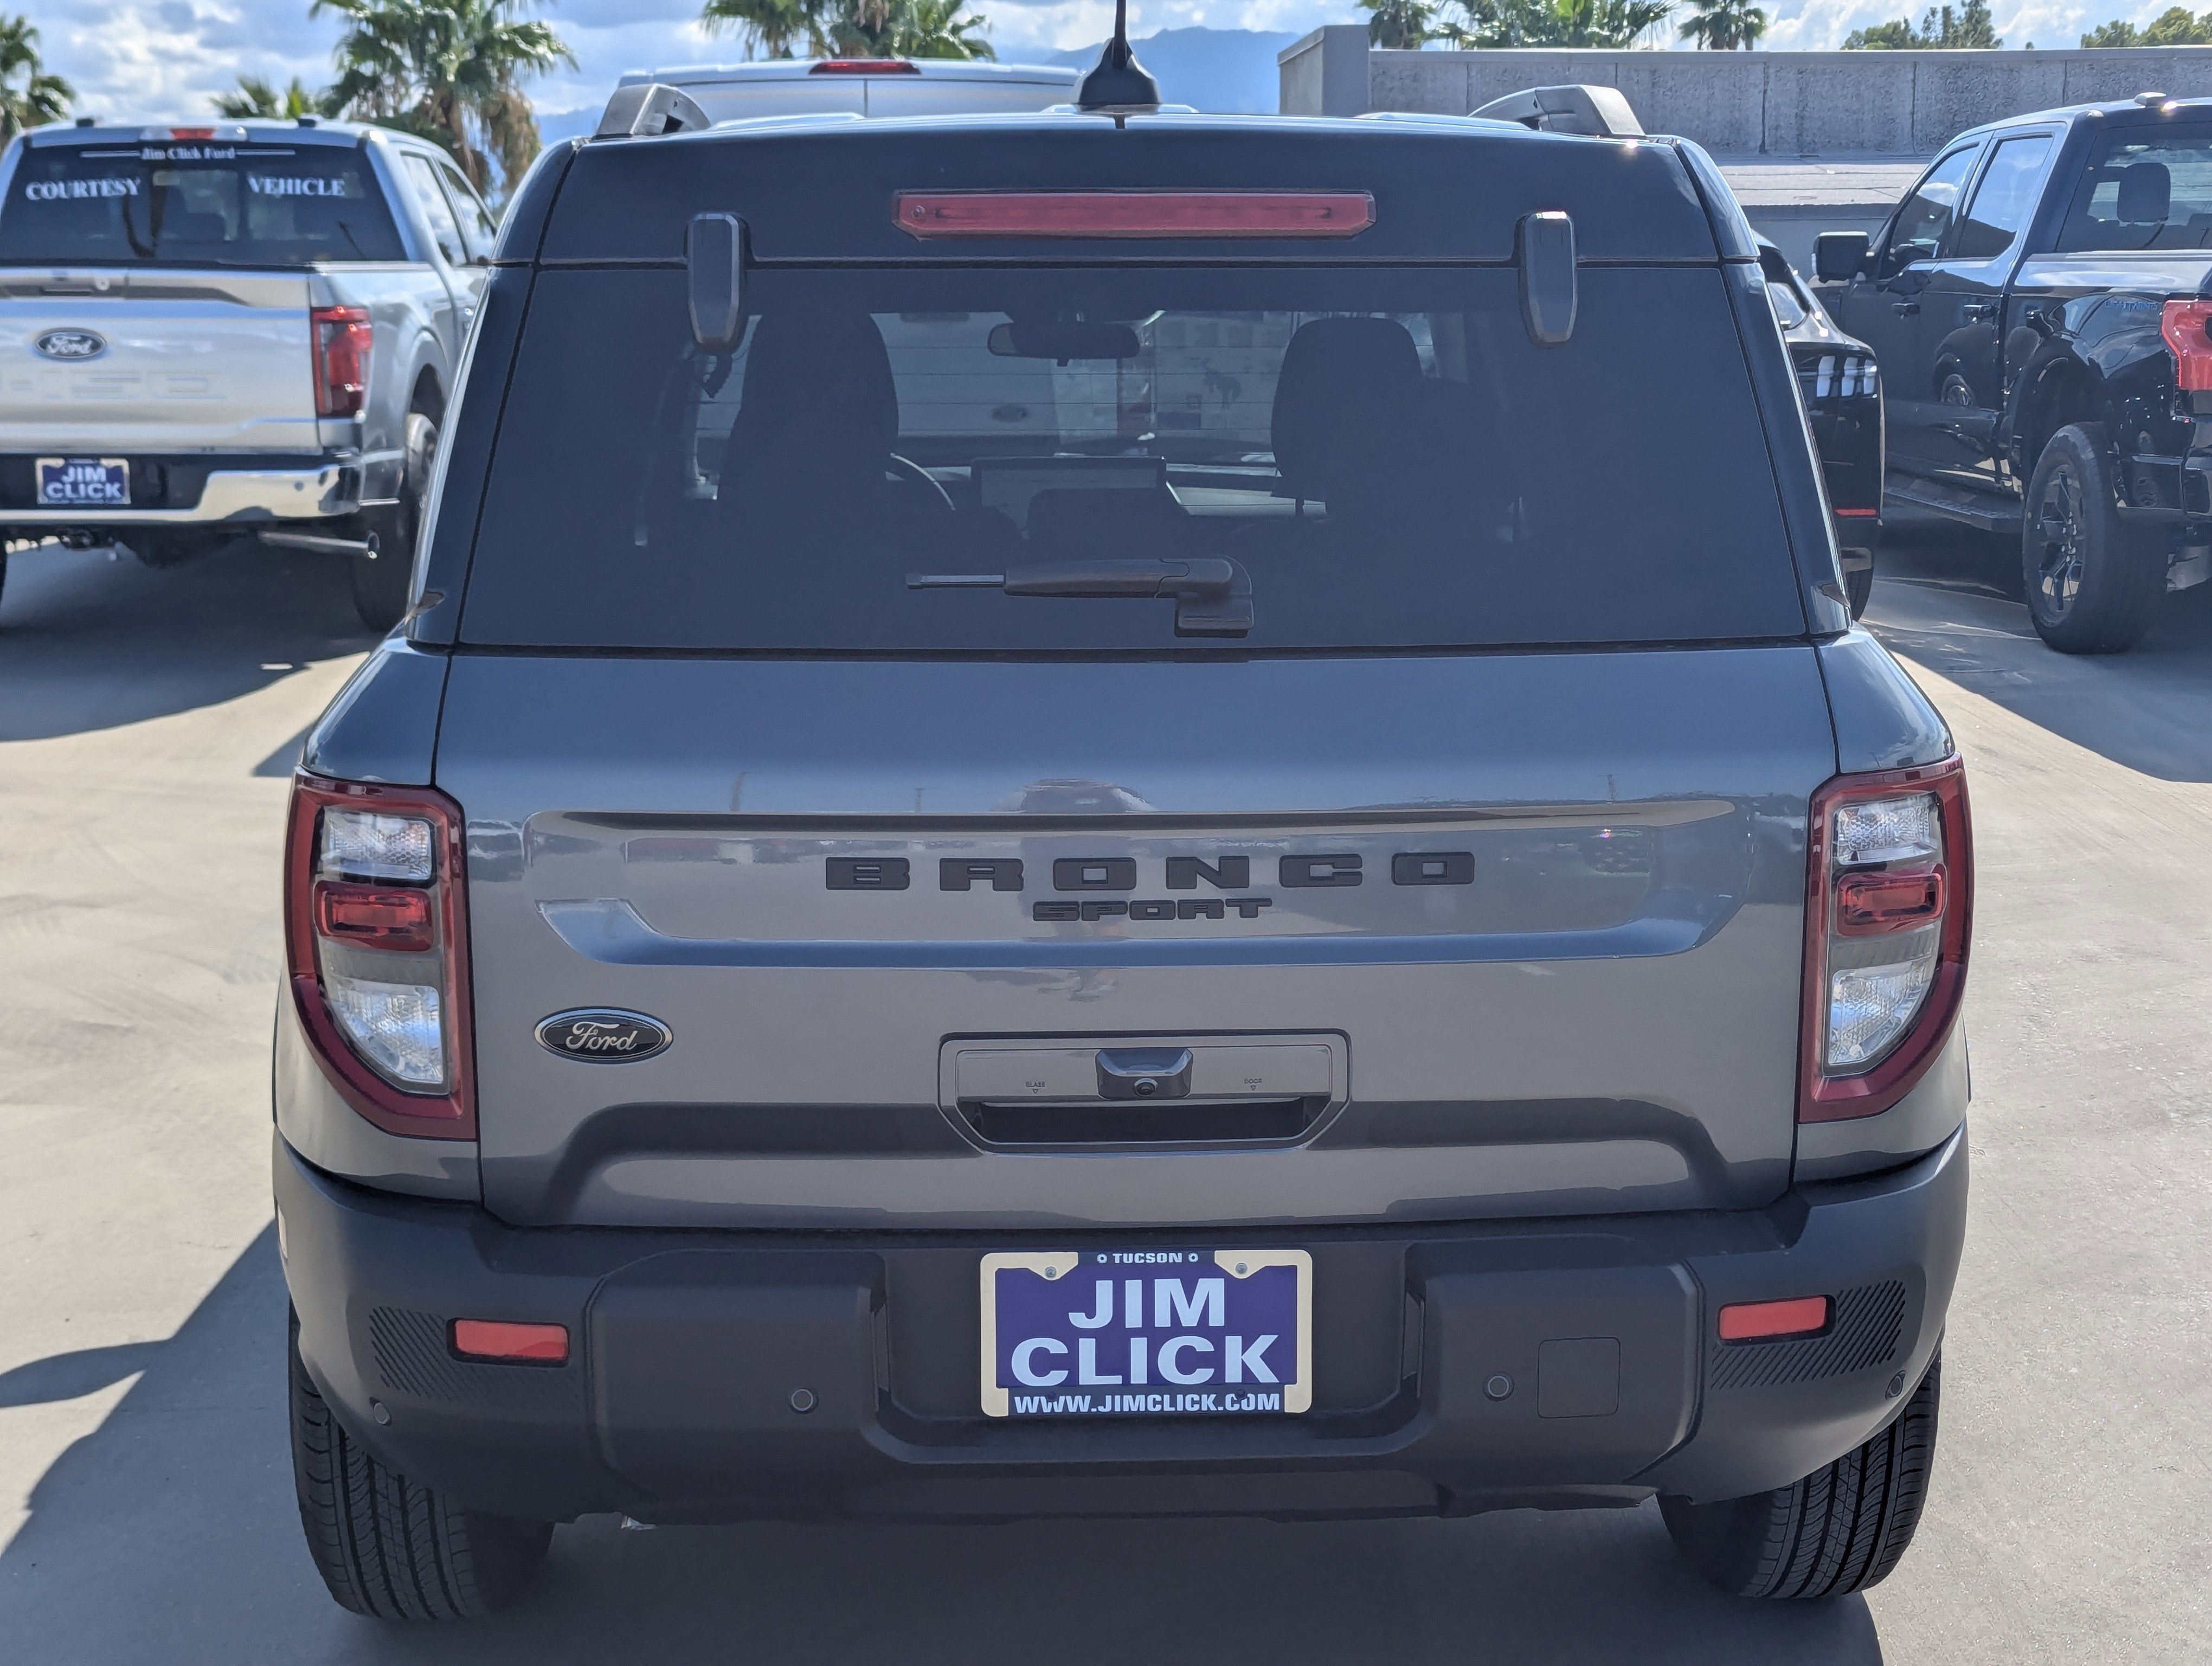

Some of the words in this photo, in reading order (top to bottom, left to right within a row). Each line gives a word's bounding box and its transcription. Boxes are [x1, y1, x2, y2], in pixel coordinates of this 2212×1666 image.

[25, 177, 141, 200] COURTESY
[247, 174, 345, 196] VEHICLE
[61, 465, 107, 483] JIM
[46, 481, 123, 498] CLICK
[825, 851, 1475, 891] BRONCO
[1032, 898, 1272, 921] SPORT
[565, 1021, 639, 1050] Ford
[1113, 1252, 1182, 1264] TUCSON
[1068, 1278, 1225, 1329] JIM
[1011, 1334, 1280, 1387] CLICK
[1014, 1392, 1280, 1414] WWW.JIMCLICK.COM
